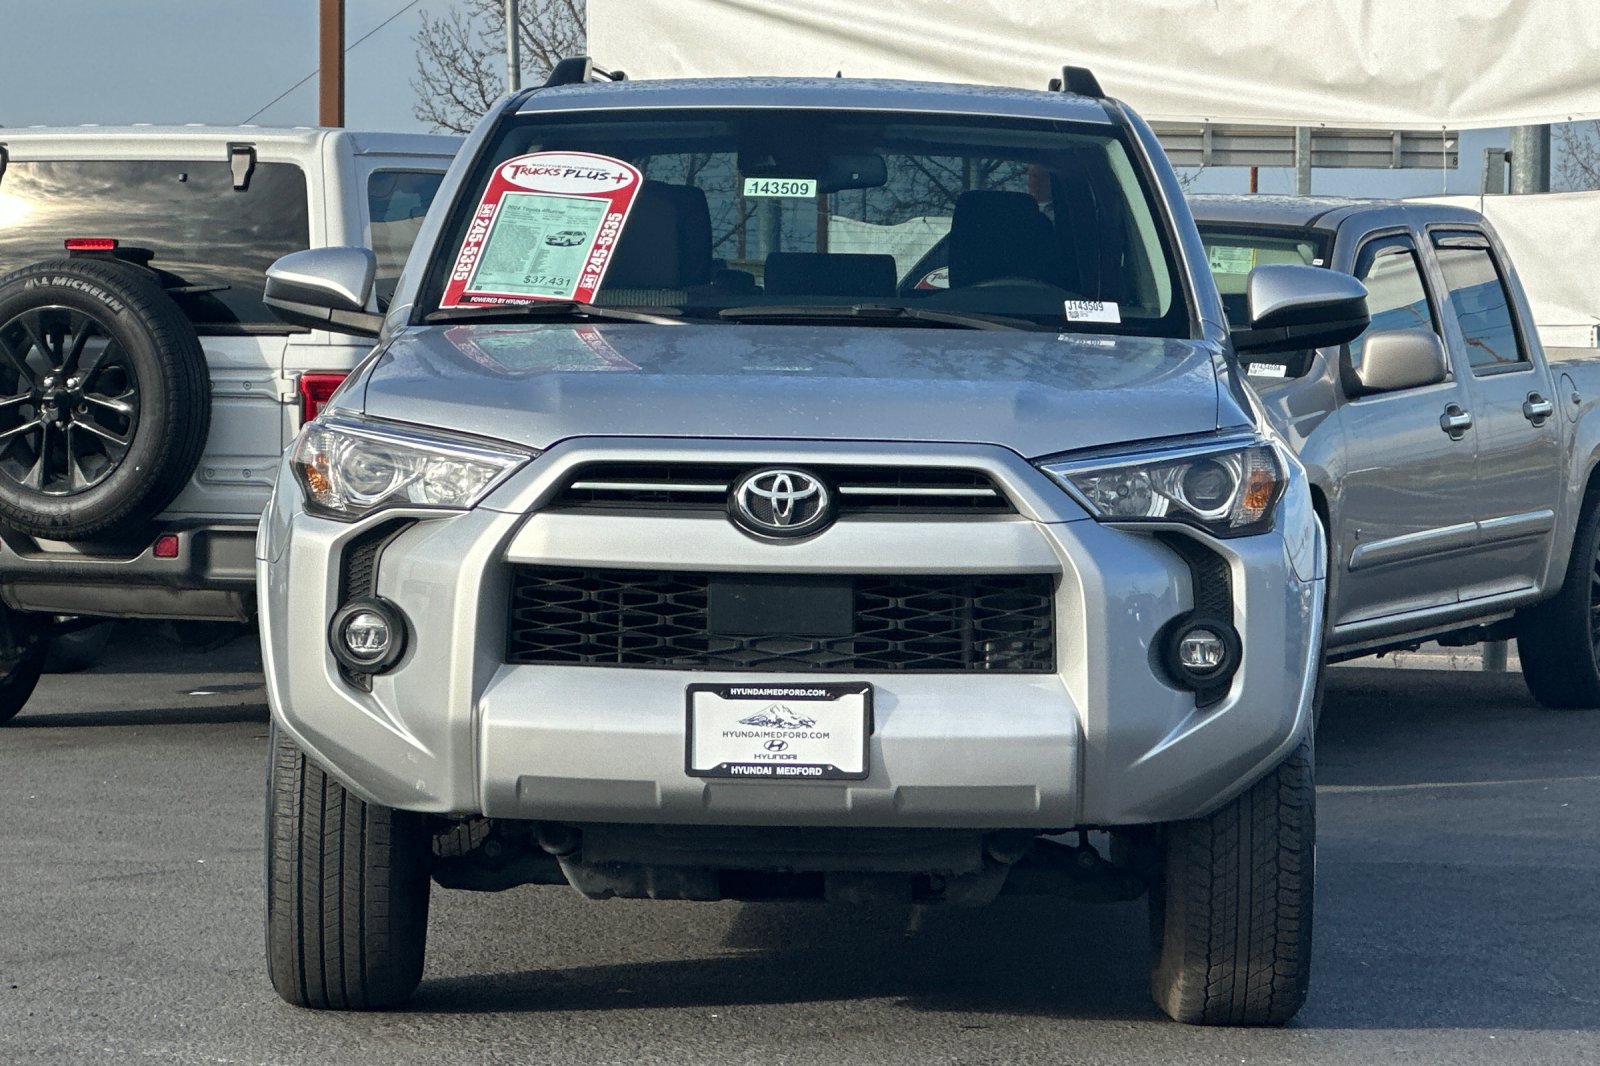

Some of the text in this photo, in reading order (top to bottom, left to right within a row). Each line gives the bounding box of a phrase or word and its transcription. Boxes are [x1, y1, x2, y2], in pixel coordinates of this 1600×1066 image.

[751, 181, 809, 195] 143509
[586, 212, 623, 274] 245-5335
[453, 218, 490, 281] 245-5335
[523, 275, 571, 287] $37,431
[51, 276, 123, 313] MICHELIN
[1068, 300, 1104, 312] J143509
[730, 688, 826, 697] HYUNDAIMEDFORD.COM
[722, 730, 830, 739] HYUNDAIMEDFORD.COM
[730, 766, 823, 776] HYUNDAI MEDFORD
